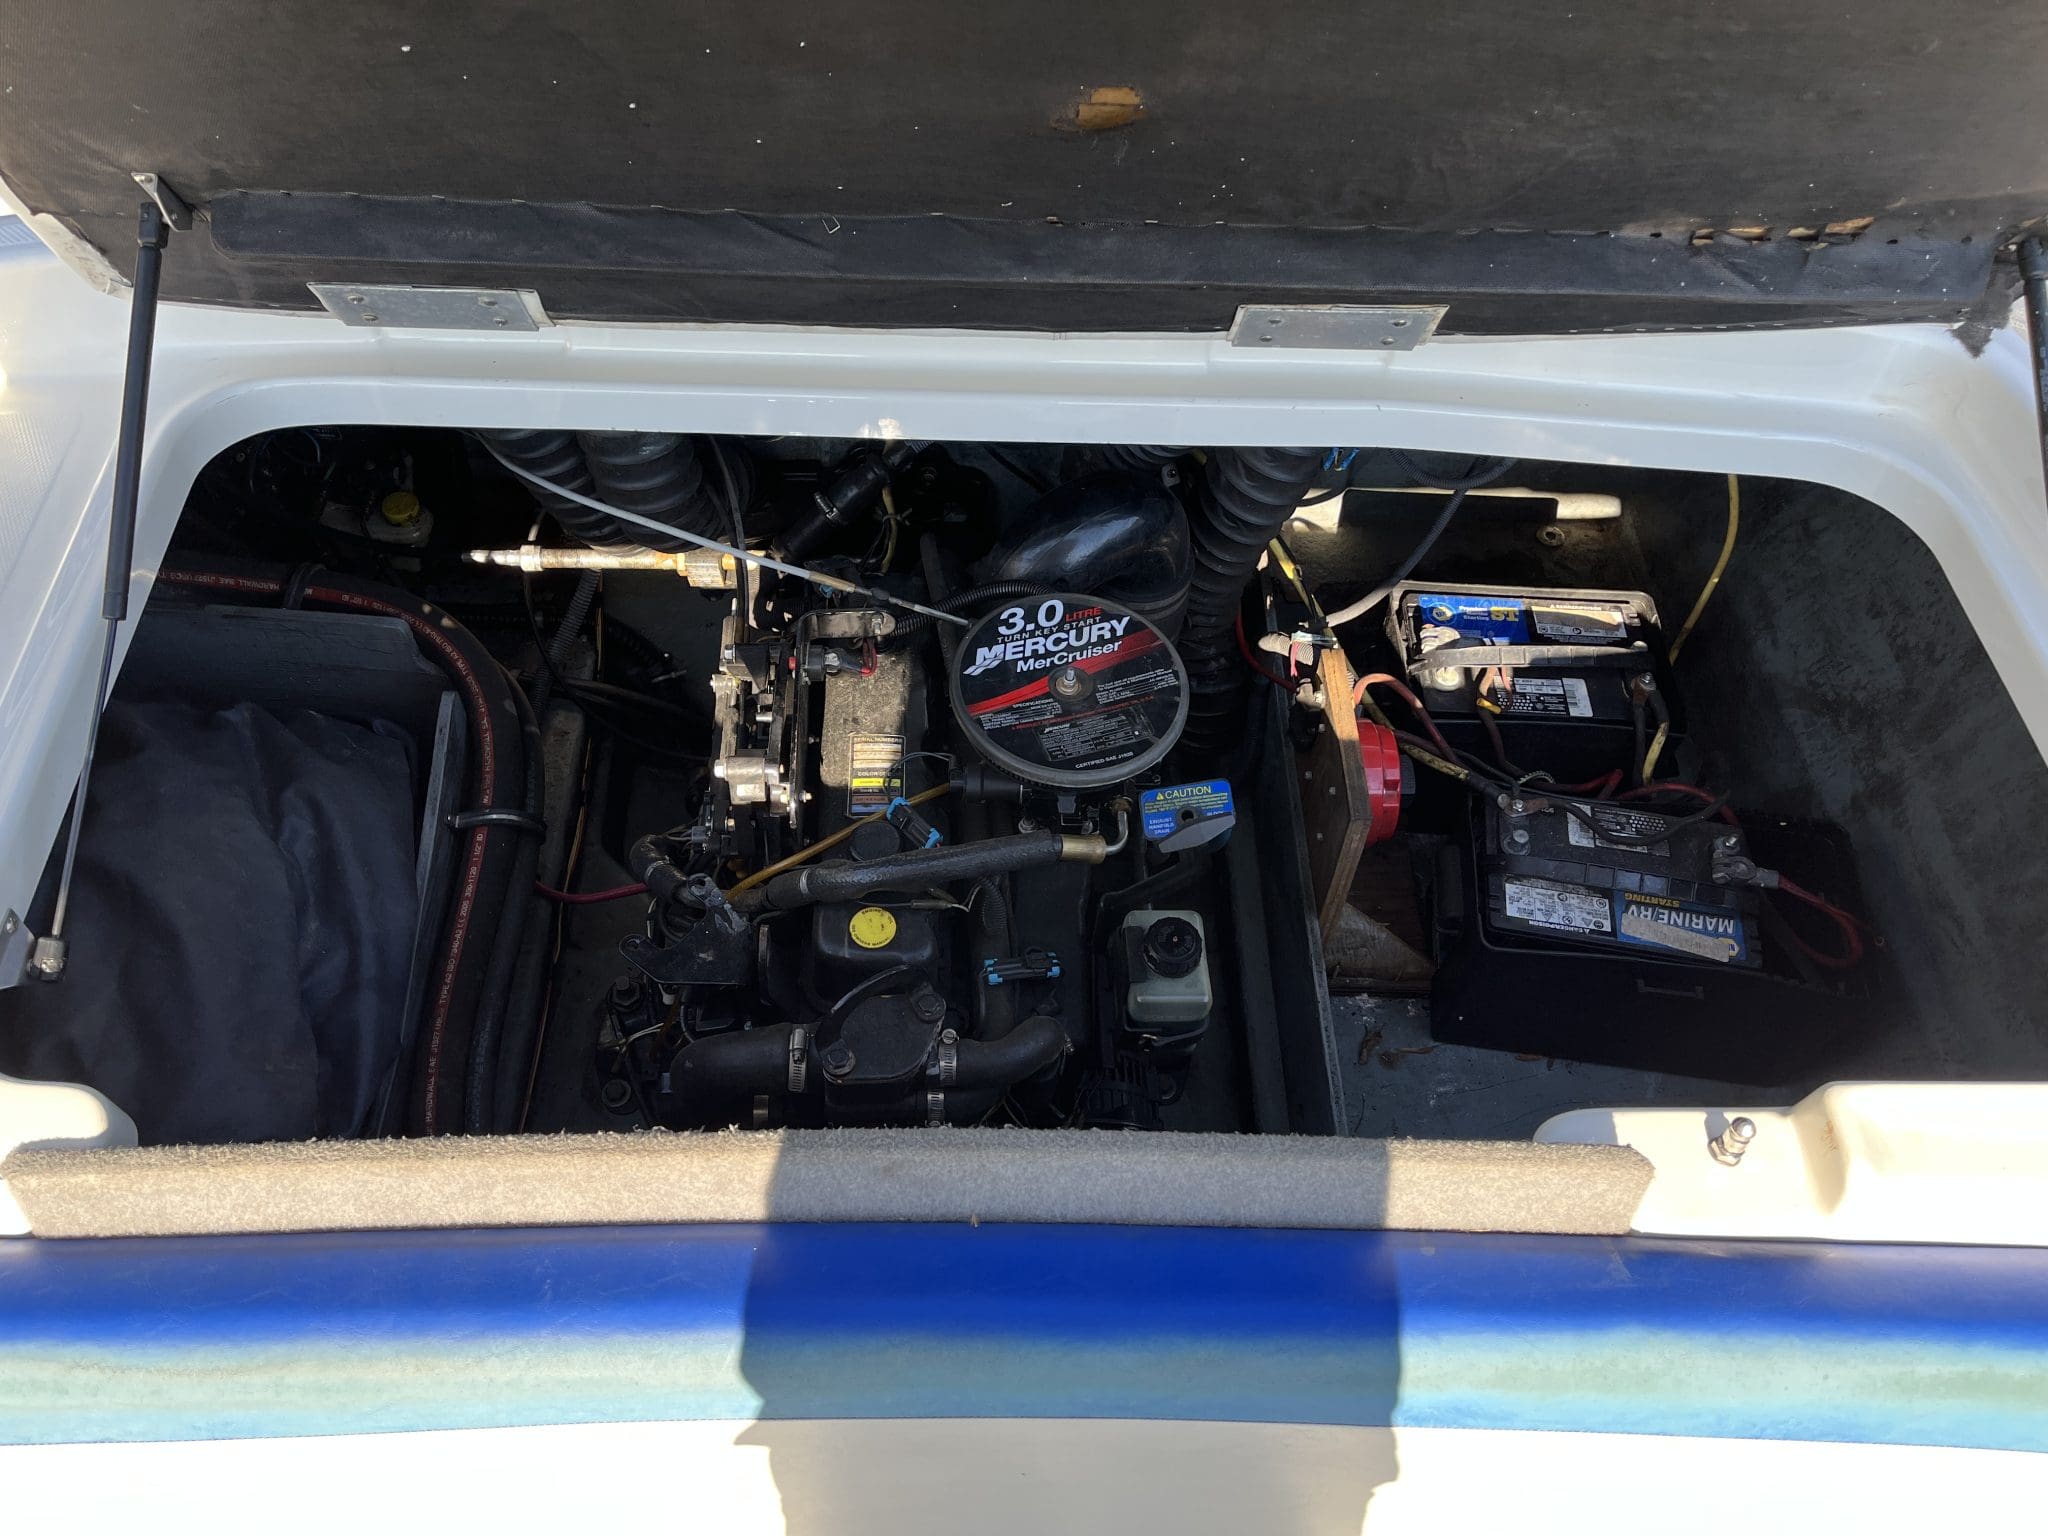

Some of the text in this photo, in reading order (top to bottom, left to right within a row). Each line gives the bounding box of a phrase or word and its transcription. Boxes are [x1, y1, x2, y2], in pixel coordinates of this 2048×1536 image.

[239, 579, 280, 591] HARDWALL
[997, 616, 1101, 644] TURN KEY START
[998, 599, 1103, 636] 3.0 LITRE
[972, 616, 1131, 668] MERCURY
[1016, 639, 1123, 673] MerCruiser
[1075, 758, 1105, 769] CERTIFIED
[1105, 755, 1118, 764] SAE
[1165, 785, 1212, 799] CAUTION
[1625, 892, 1680, 908] STARTING
[1627, 904, 1734, 934] MARINE/RV
[426, 1074, 435, 1122] HARDWALL
[440, 984, 450, 1004] TYPE
[476, 833, 484, 842] ID
